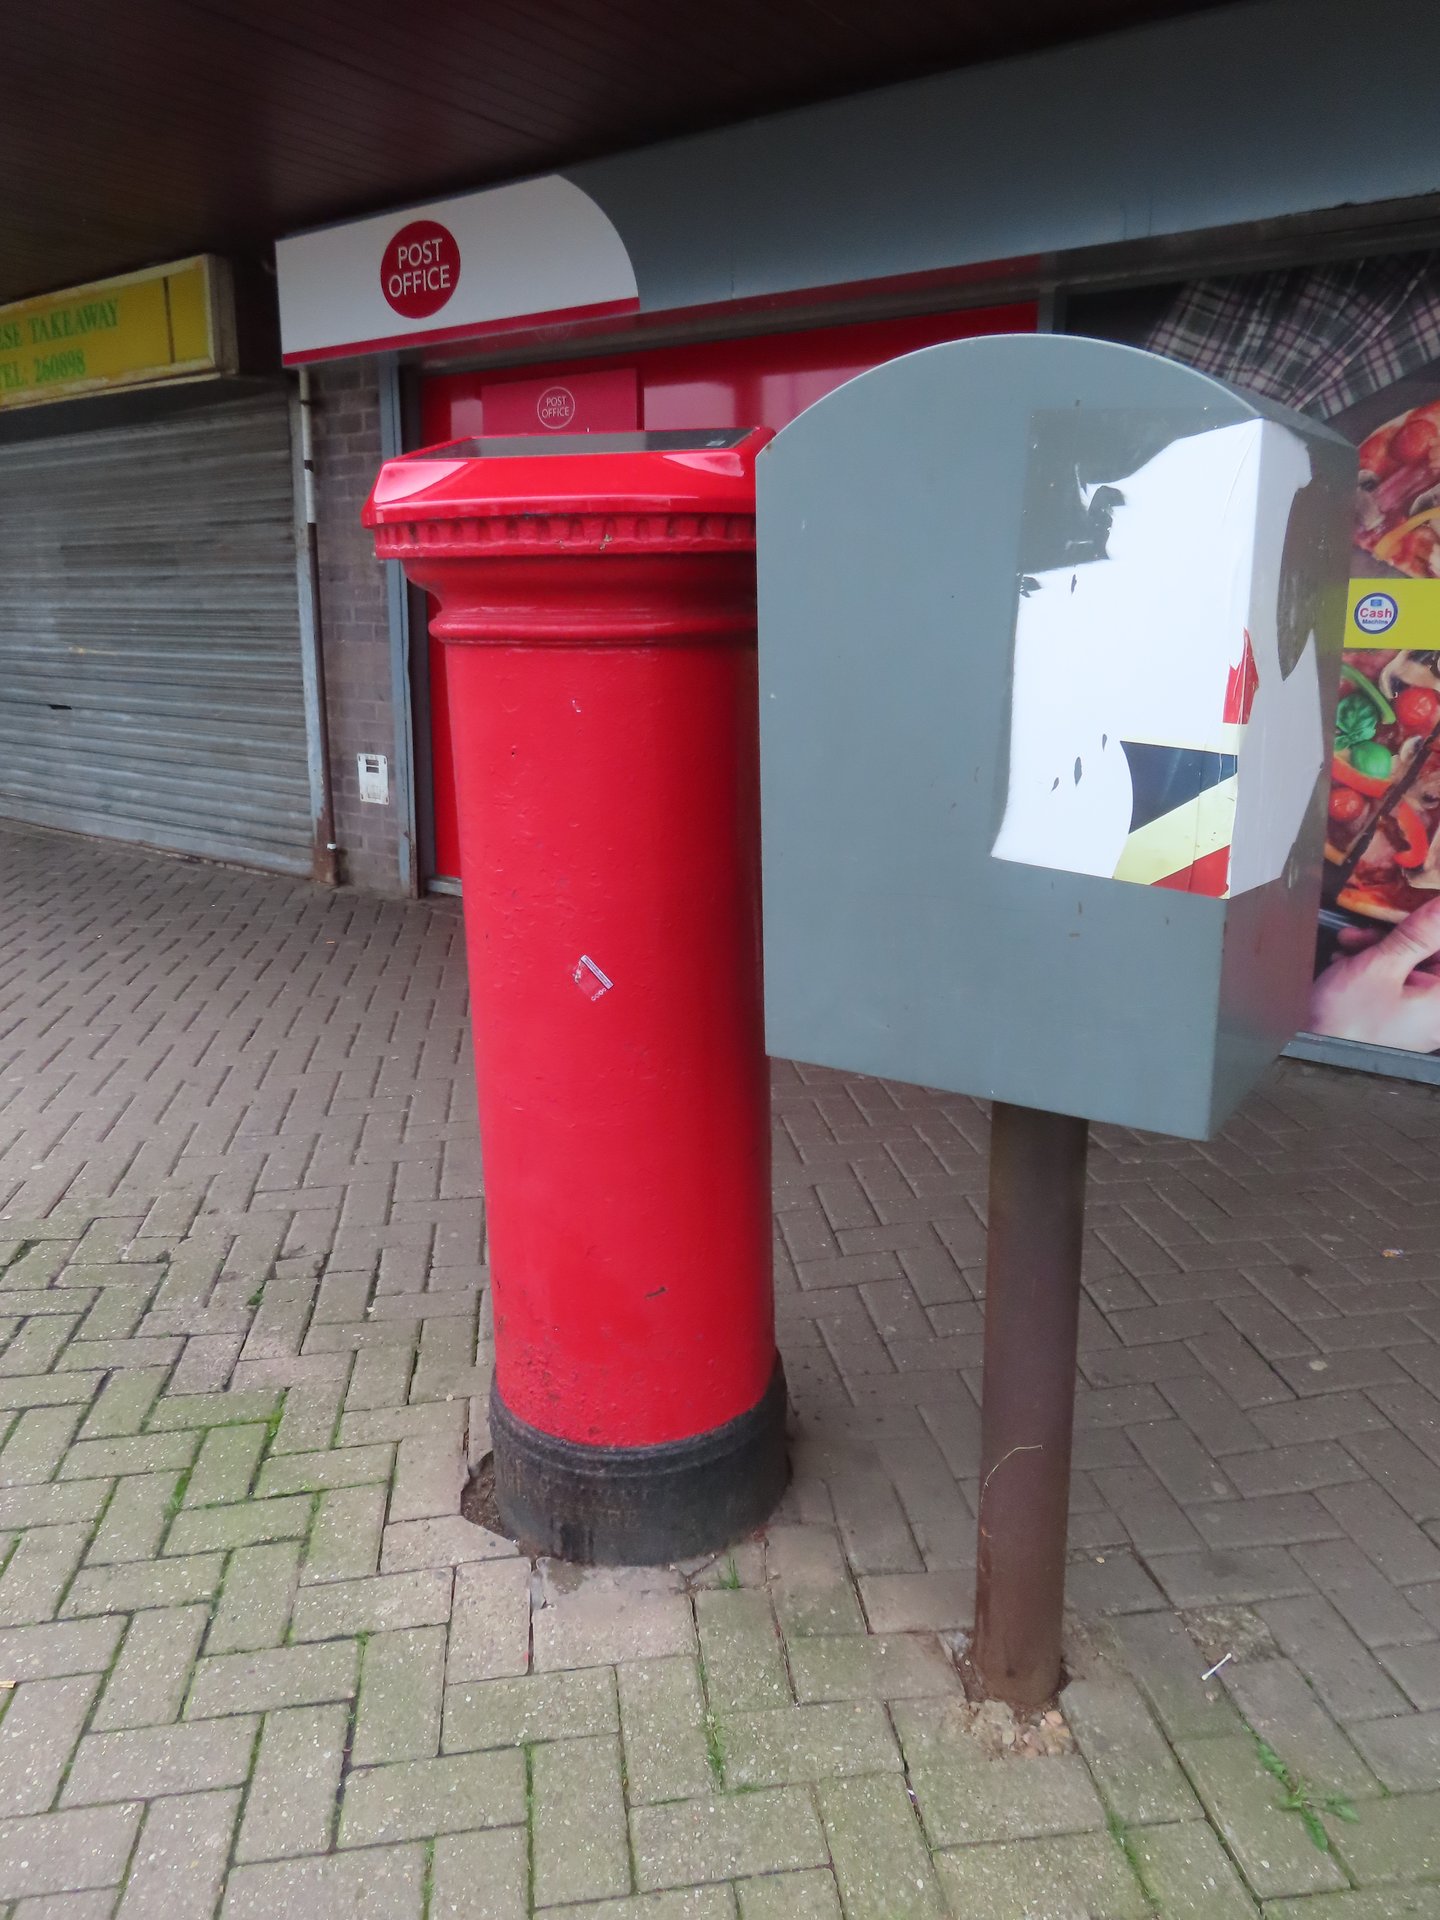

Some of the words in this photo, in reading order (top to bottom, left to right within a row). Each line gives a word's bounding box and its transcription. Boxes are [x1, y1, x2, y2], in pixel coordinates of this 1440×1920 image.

[397, 238, 443, 269] POST
[388, 264, 451, 298] OFFICE
[27, 298, 119, 344] TAKEAWAY
[546, 395, 567, 407] POST
[541, 406, 570, 419] OFFICE
[1359, 607, 1393, 619] Cash
